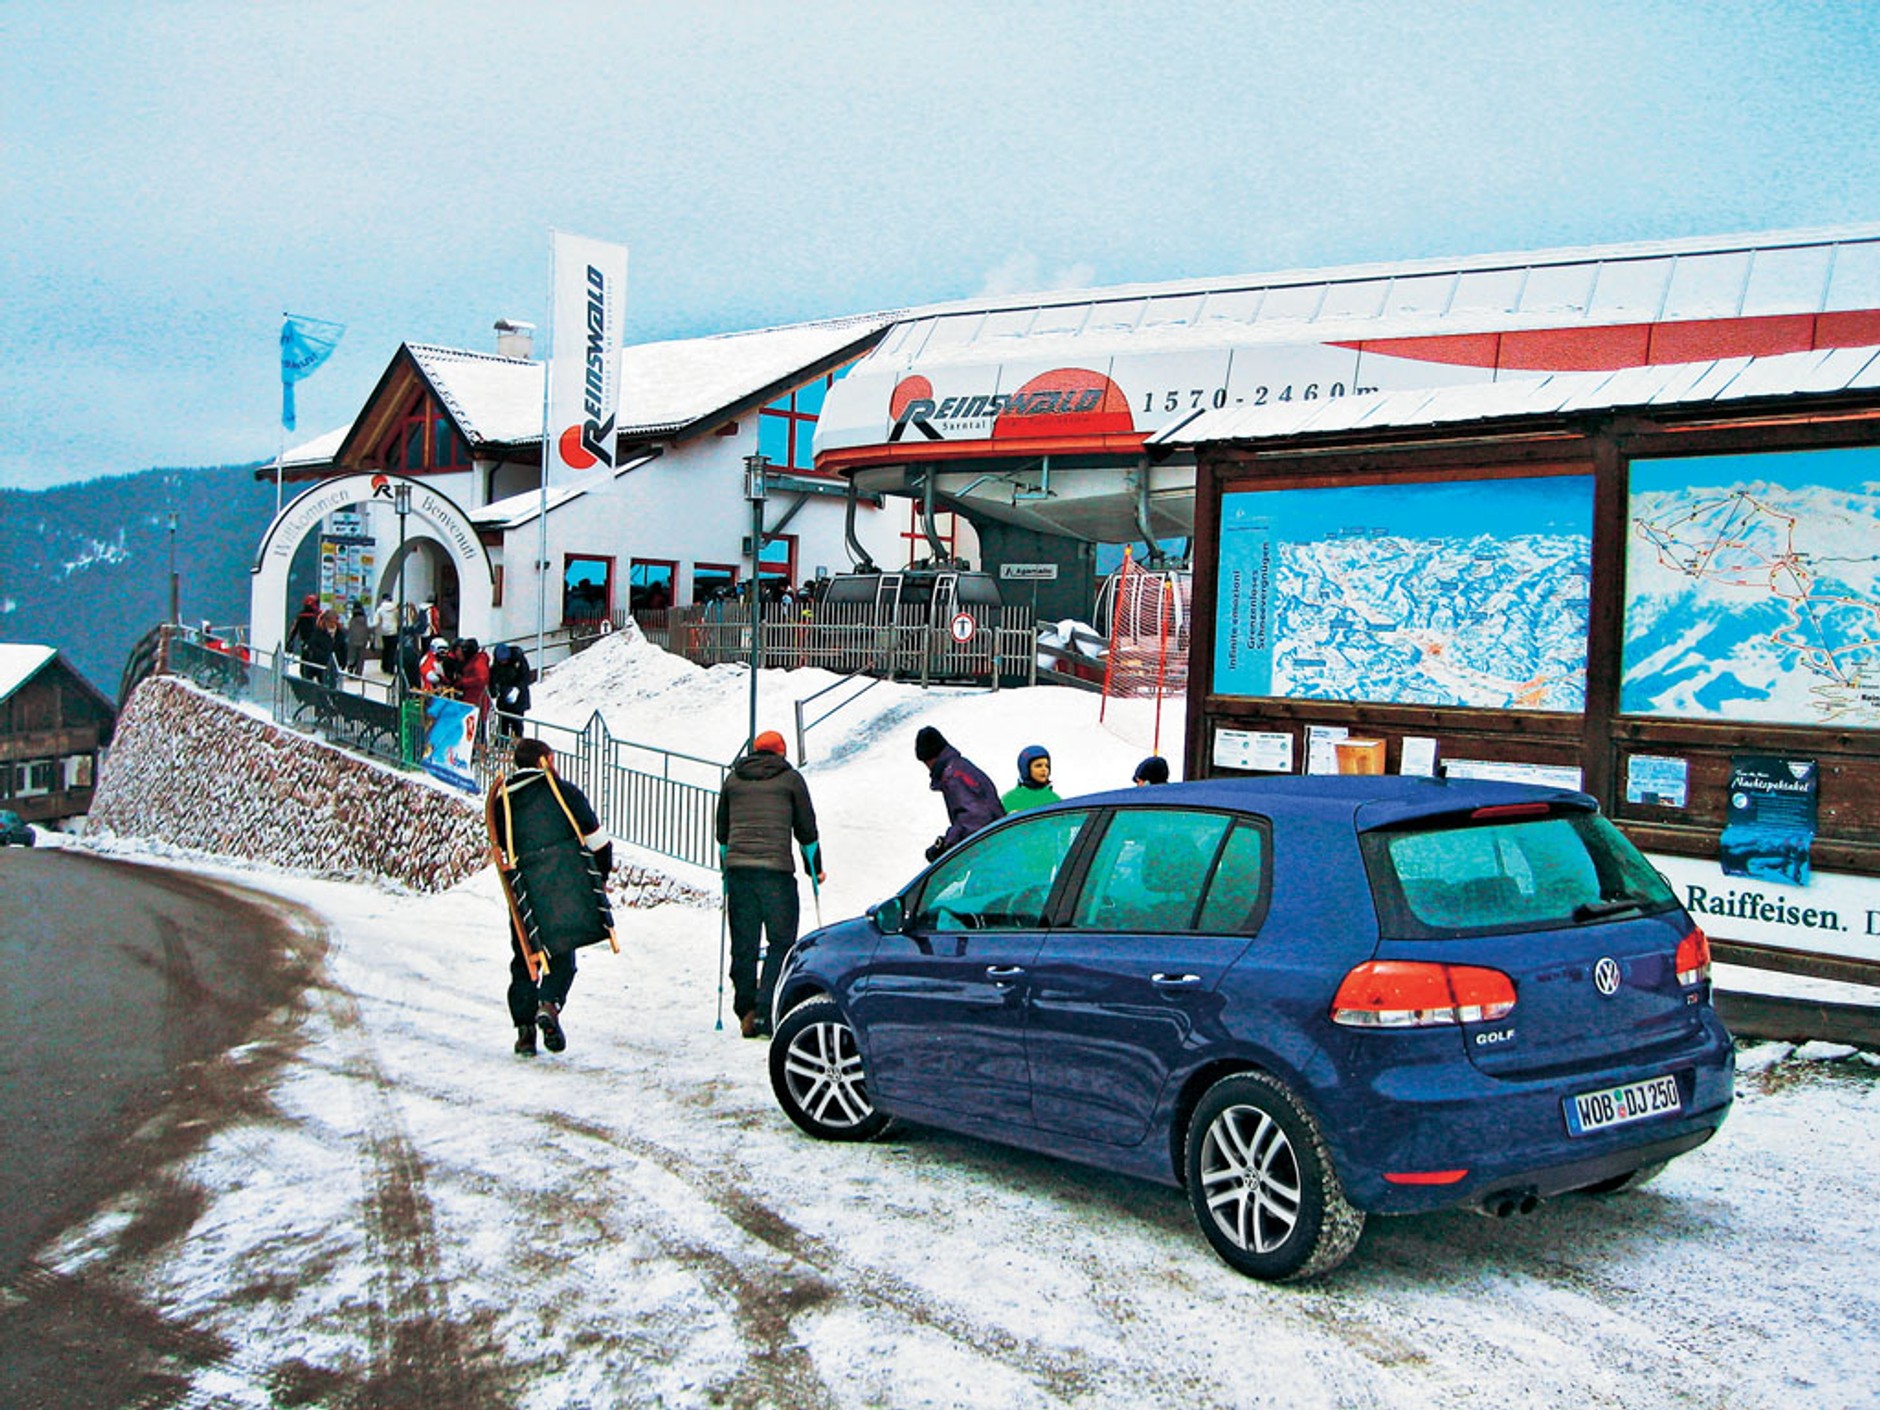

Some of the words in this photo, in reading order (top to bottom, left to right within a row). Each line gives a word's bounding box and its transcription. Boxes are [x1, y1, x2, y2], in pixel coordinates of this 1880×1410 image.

[942, 420, 986, 431] Sarntal
[274, 489, 349, 558] Willkommen
[421, 495, 478, 560] Benvenuti
[1246, 569, 1259, 650] Grenzenloses
[1256, 541, 1270, 650] Schneevergnügen
[1686, 885, 1848, 932] Raiffeisen.
[1475, 1029, 1515, 1045] GOLF
[1577, 1093, 1615, 1127] WOB
[1623, 1087, 1649, 1116] DJ
[1649, 1079, 1679, 1108] 250
